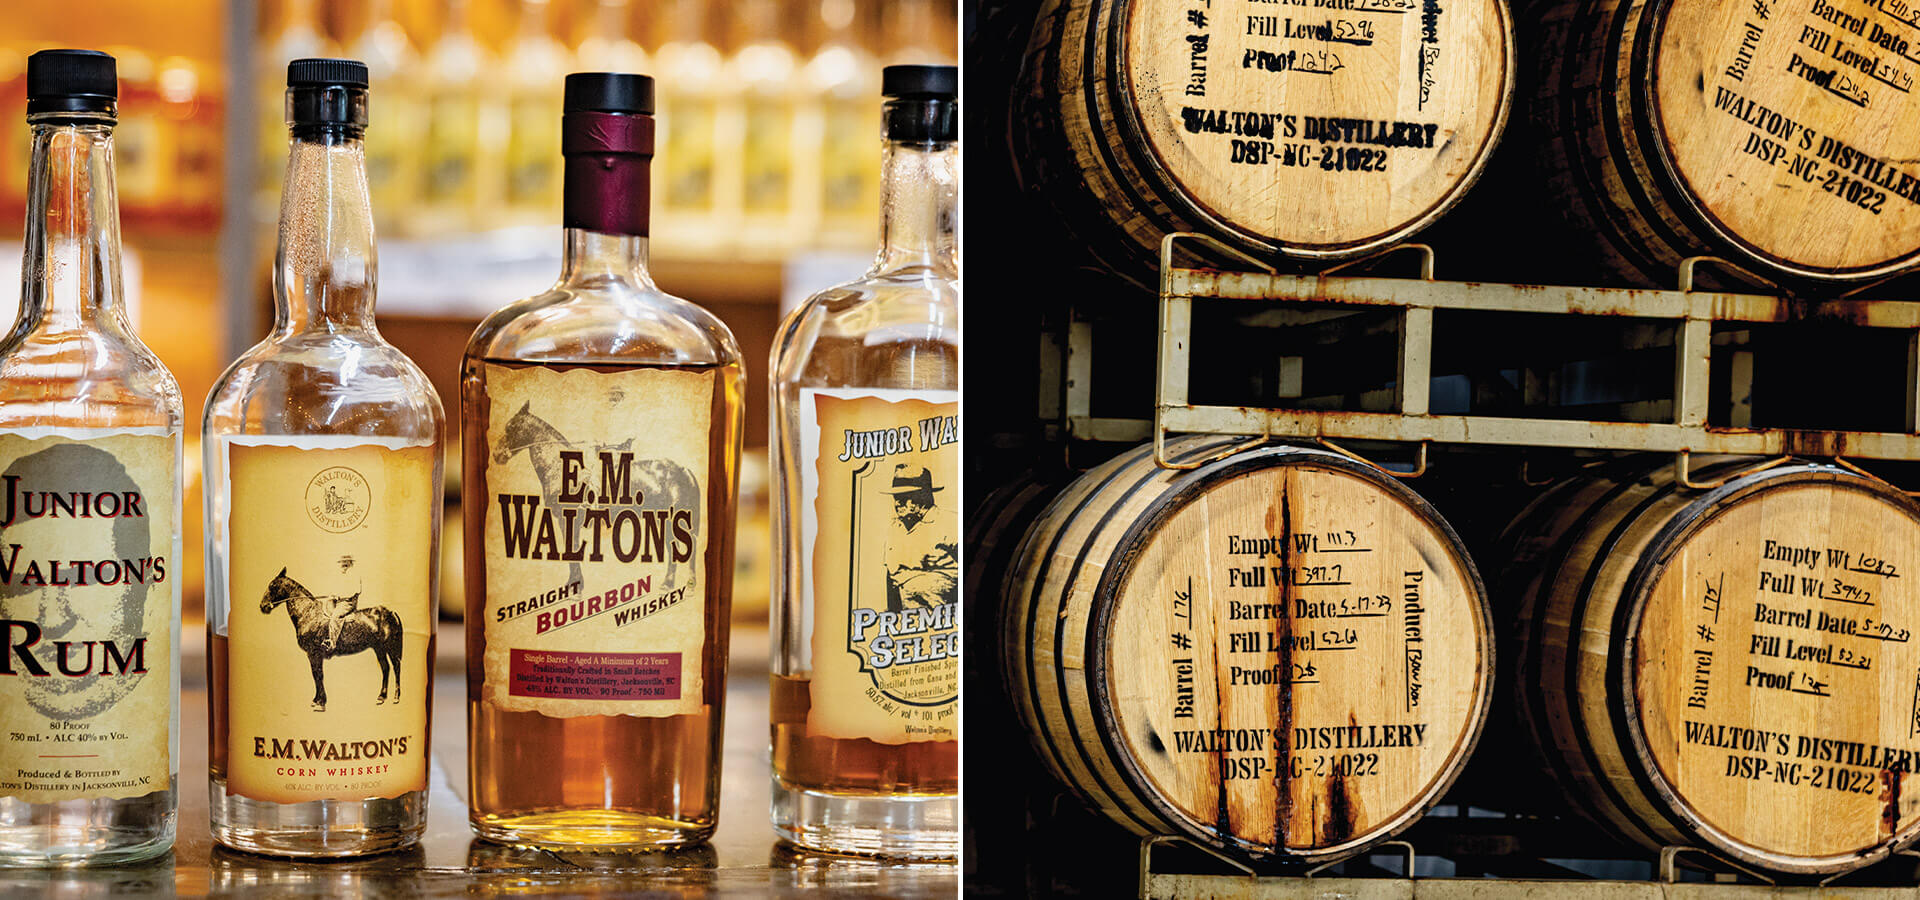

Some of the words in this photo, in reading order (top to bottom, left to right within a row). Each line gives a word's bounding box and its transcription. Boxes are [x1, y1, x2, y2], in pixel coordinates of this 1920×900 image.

[1187, 9, 1209, 29] #
[1246, 16, 1277, 37] Fill
[1284, 18, 1332, 41] Level
[1811, 0, 1868, 37] Barrel
[1868, 23, 1908, 56] Date
[1243, 48, 1296, 72] Proof
[1725, 22, 1764, 82] Barrel
[1798, 25, 1831, 54] Fill
[1831, 40, 1879, 76] Level
[1185, 34, 1209, 97] Barrel
[1786, 53, 1837, 90] Proof
[1181, 107, 1297, 139] WALTON'S
[1303, 116, 1439, 149] DISTILLERY
[1714, 86, 1816, 150] WALTON'S
[1231, 139, 1387, 172] DSP-NC-21022
[1743, 132, 1887, 215] DSP-NC-21022
[838, 426, 913, 462] JUNIOR
[918, 415, 958, 452] WA
[314, 471, 361, 488] WALTON'S
[559, 451, 643, 505] E.M.
[0, 475, 143, 529] JUNIOR
[312, 506, 363, 528] DISTILLERY
[498, 493, 693, 563] WALTON'S
[1294, 534, 1318, 553] Wt
[1763, 539, 1821, 570] Empty
[1827, 549, 1850, 570] Wt
[1229, 567, 1265, 587] Full
[1302, 565, 1342, 584] 397.7
[1759, 571, 1795, 595] Full
[1801, 577, 1824, 599] Wt
[497, 581, 581, 622] STRAIGHT
[536, 575, 652, 634] BOURBON
[614, 587, 686, 627] WHISKEY
[1174, 590, 1190, 618] 176
[1230, 600, 1288, 620] Barre
[1295, 598, 1336, 618] Date
[1404, 571, 1425, 642] Product
[1696, 624, 1716, 643] #
[1754, 603, 1812, 629] Barrel
[1816, 611, 1857, 636] Date
[1171, 632, 1192, 650] #
[1230, 633, 1260, 653] Fill
[1267, 631, 1315, 651] Lvel
[1750, 635, 1781, 657] Fill
[1785, 639, 1833, 664] Level
[524, 653, 545, 664] Single
[547, 655, 568, 664] Barrel
[575, 656, 592, 666] Aged
[1173, 658, 1194, 718] Barrel
[1231, 665, 1281, 685] Proof
[1688, 650, 1713, 709] Barrel
[1746, 666, 1795, 690] Proof
[10, 732, 25, 742] 750
[53, 734, 76, 742] ALC
[78, 733, 97, 742] 40%
[50, 722, 60, 730] 80
[1295, 723, 1427, 750] DISTILLERY
[1685, 721, 1790, 767] WALTON'S
[17, 769, 61, 778] Produced
[64, 770, 72, 778] &
[139, 776, 151, 785] NC
[277, 767, 316, 776] CORN
[327, 764, 389, 776] WHISKEY
[1223, 753, 1378, 780] DSP-C-21022
[1725, 755, 1875, 795] DSP-NC-21022
